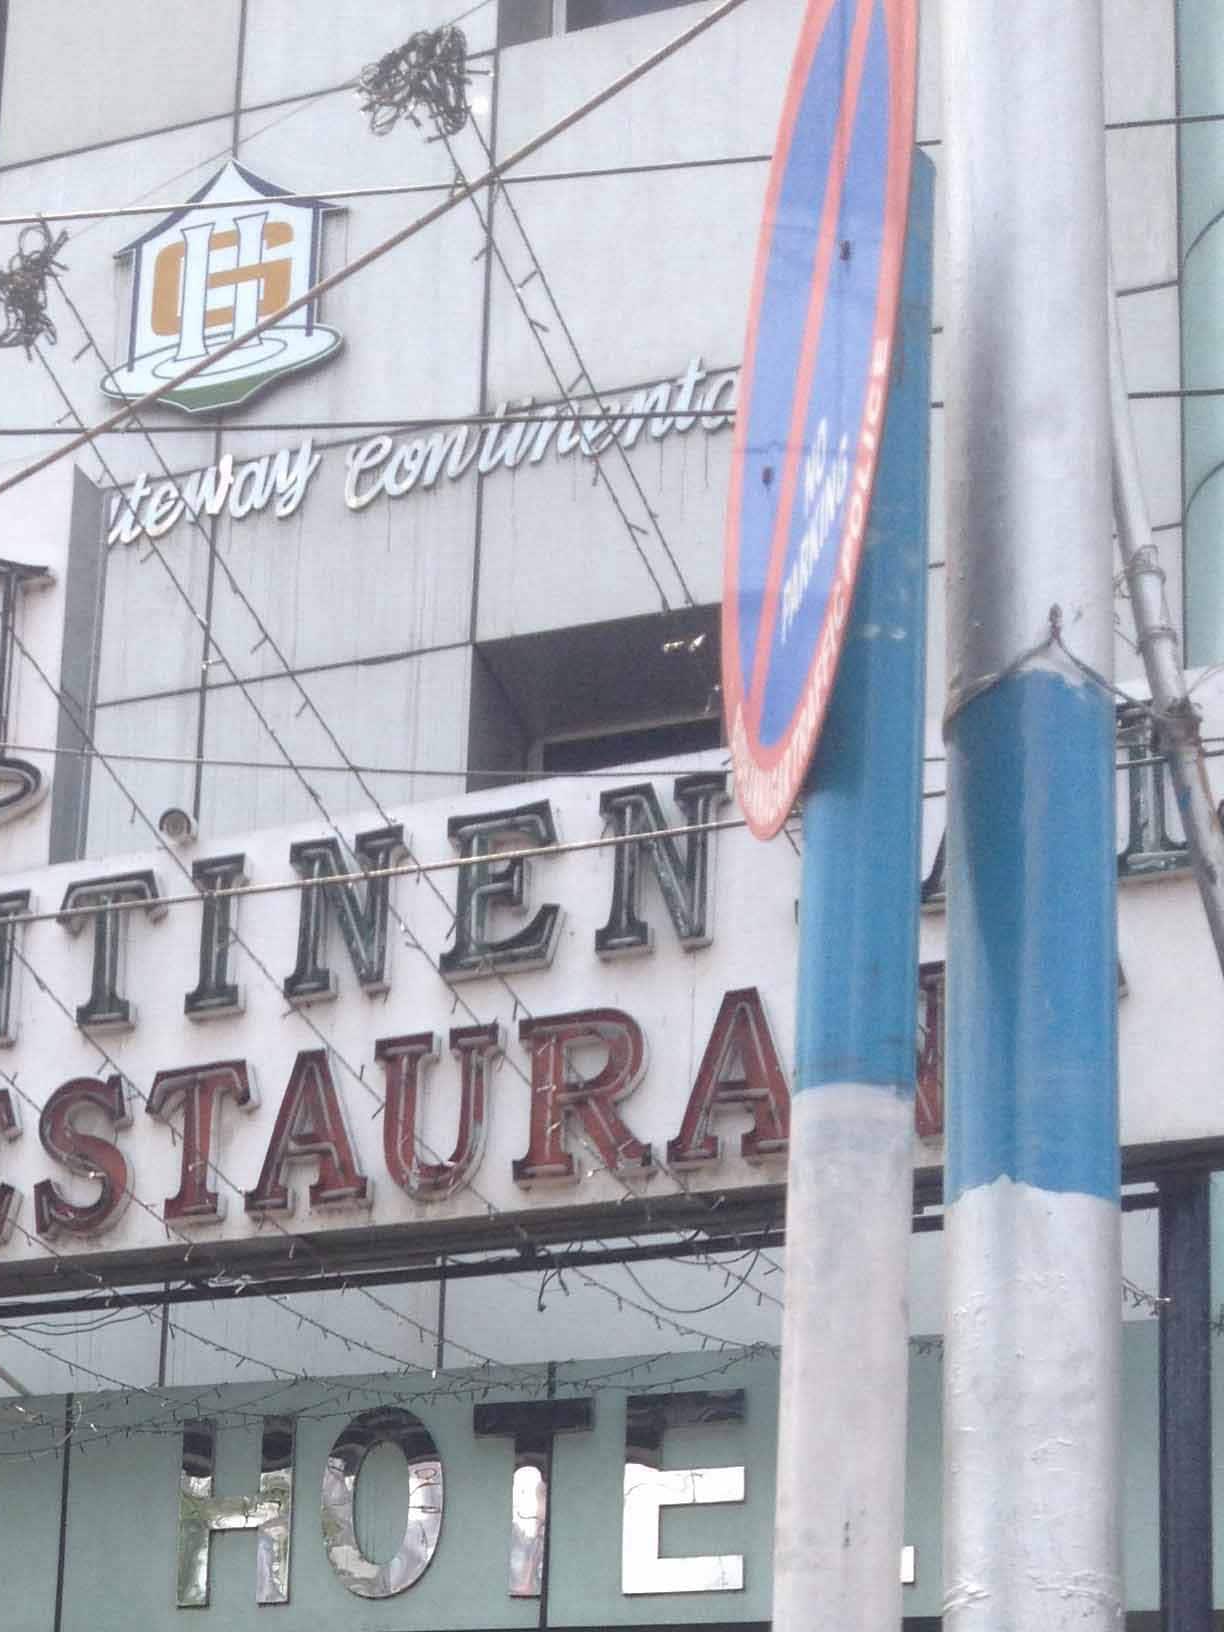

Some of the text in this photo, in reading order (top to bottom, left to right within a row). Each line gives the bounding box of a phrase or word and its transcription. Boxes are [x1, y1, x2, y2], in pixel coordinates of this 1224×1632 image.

[107, 357, 739, 545] teway Continenta
[781, 432, 849, 643] PARKING
[805, 416, 828, 515] NO
[176, 1388, 916, 1608] HOTE
